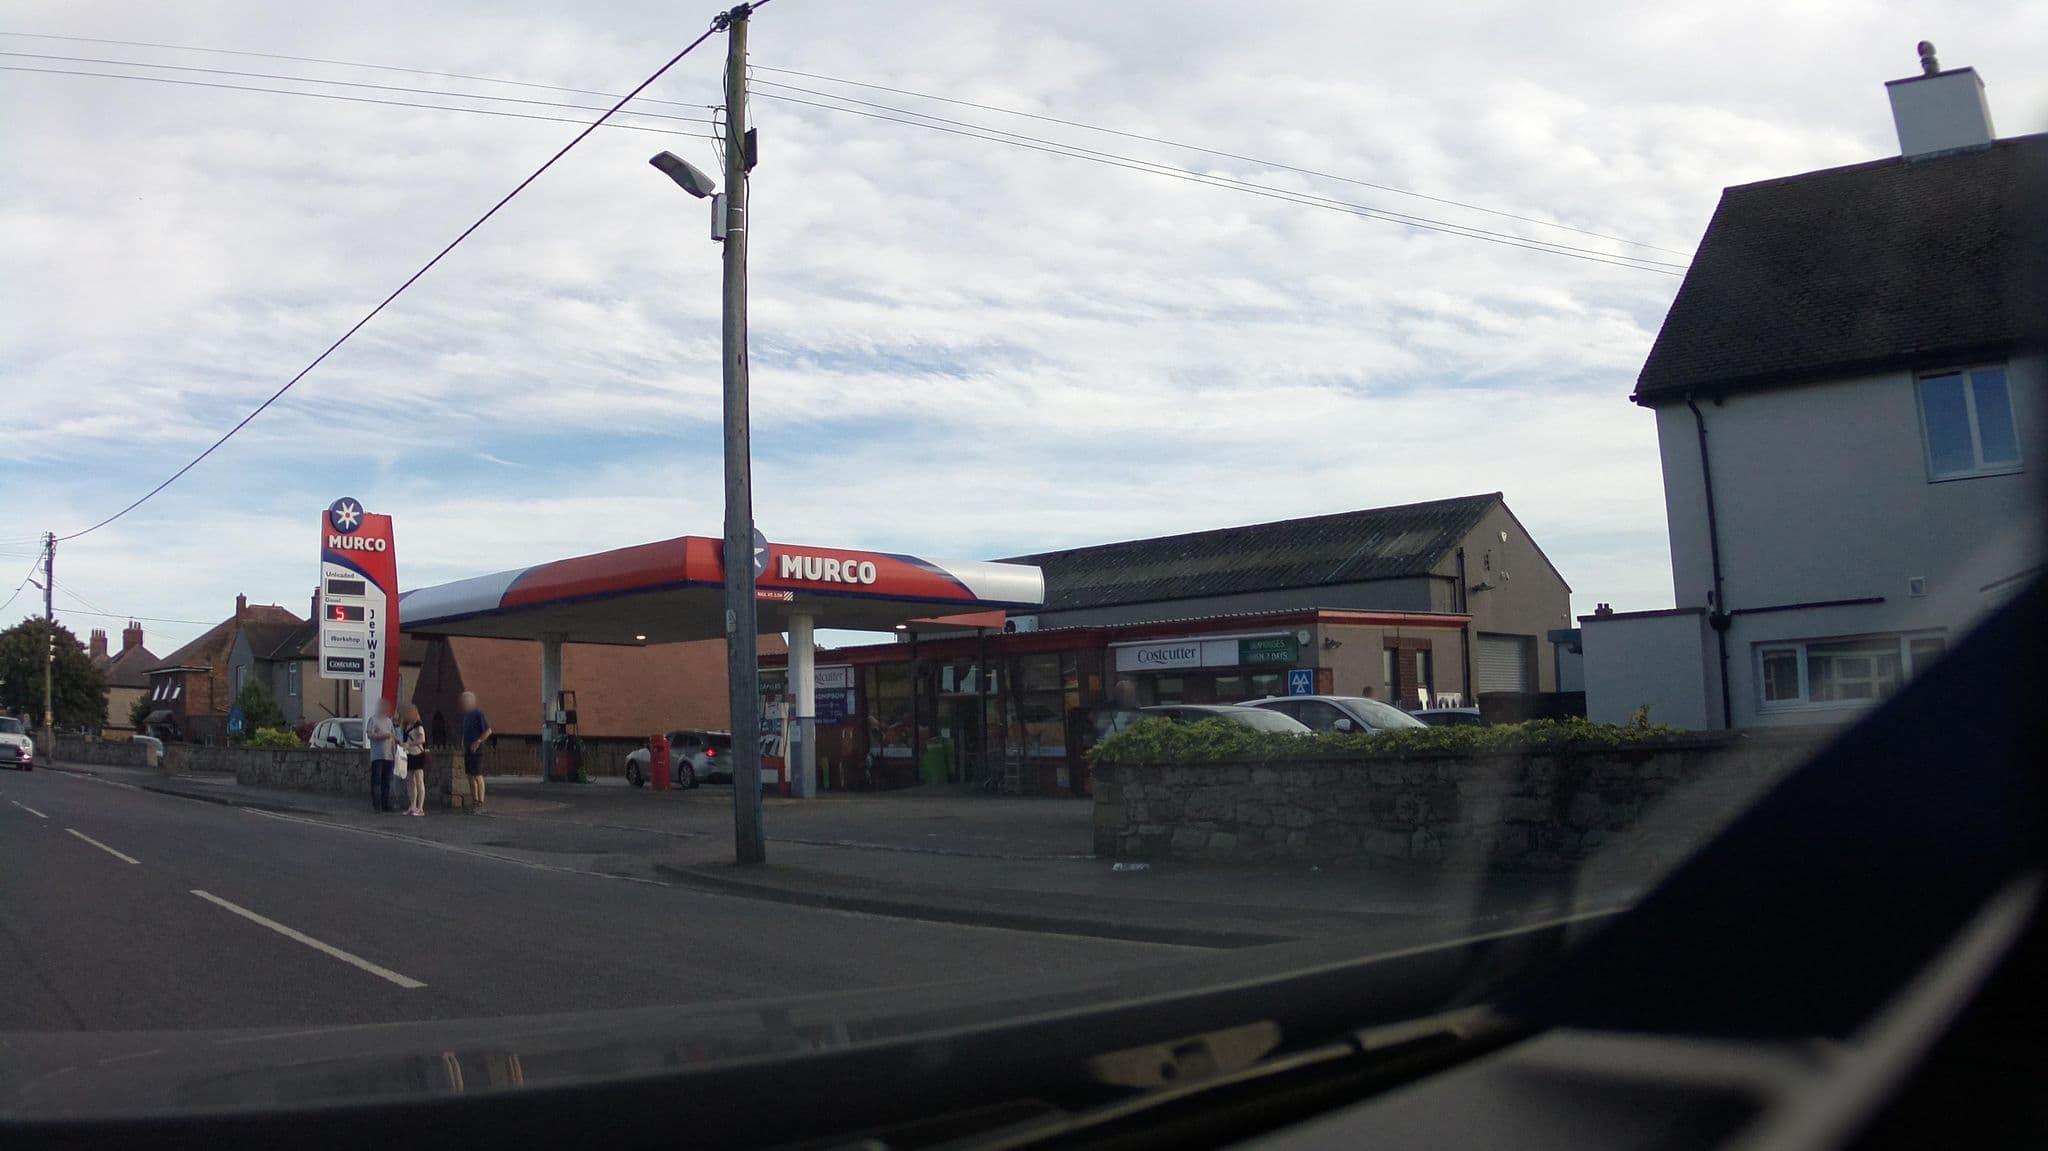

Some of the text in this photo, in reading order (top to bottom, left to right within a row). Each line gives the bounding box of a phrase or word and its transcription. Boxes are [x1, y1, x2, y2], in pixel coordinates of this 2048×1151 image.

[329, 535, 386, 552] MURCO
[781, 554, 877, 585] MURCO
[335, 606, 345, 622] 5
[330, 635, 361, 643] Workshop
[1137, 647, 1197, 664] Costcutter
